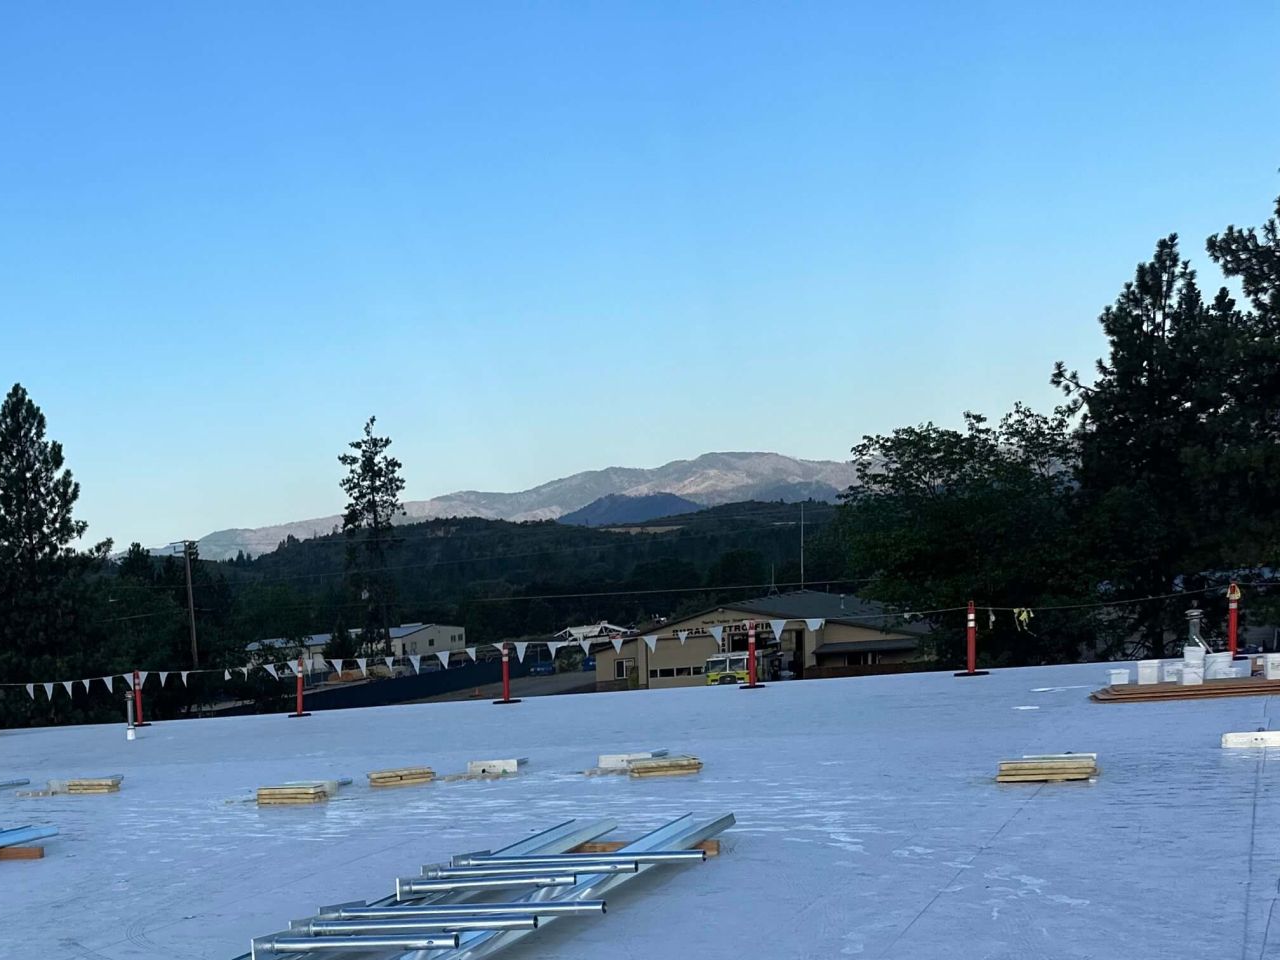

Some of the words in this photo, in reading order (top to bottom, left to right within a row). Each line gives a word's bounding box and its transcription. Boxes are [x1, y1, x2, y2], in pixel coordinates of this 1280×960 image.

[672, 627, 707, 637] RURAL
[720, 623, 749, 633] ETRO
[755, 622, 774, 631] FIR
